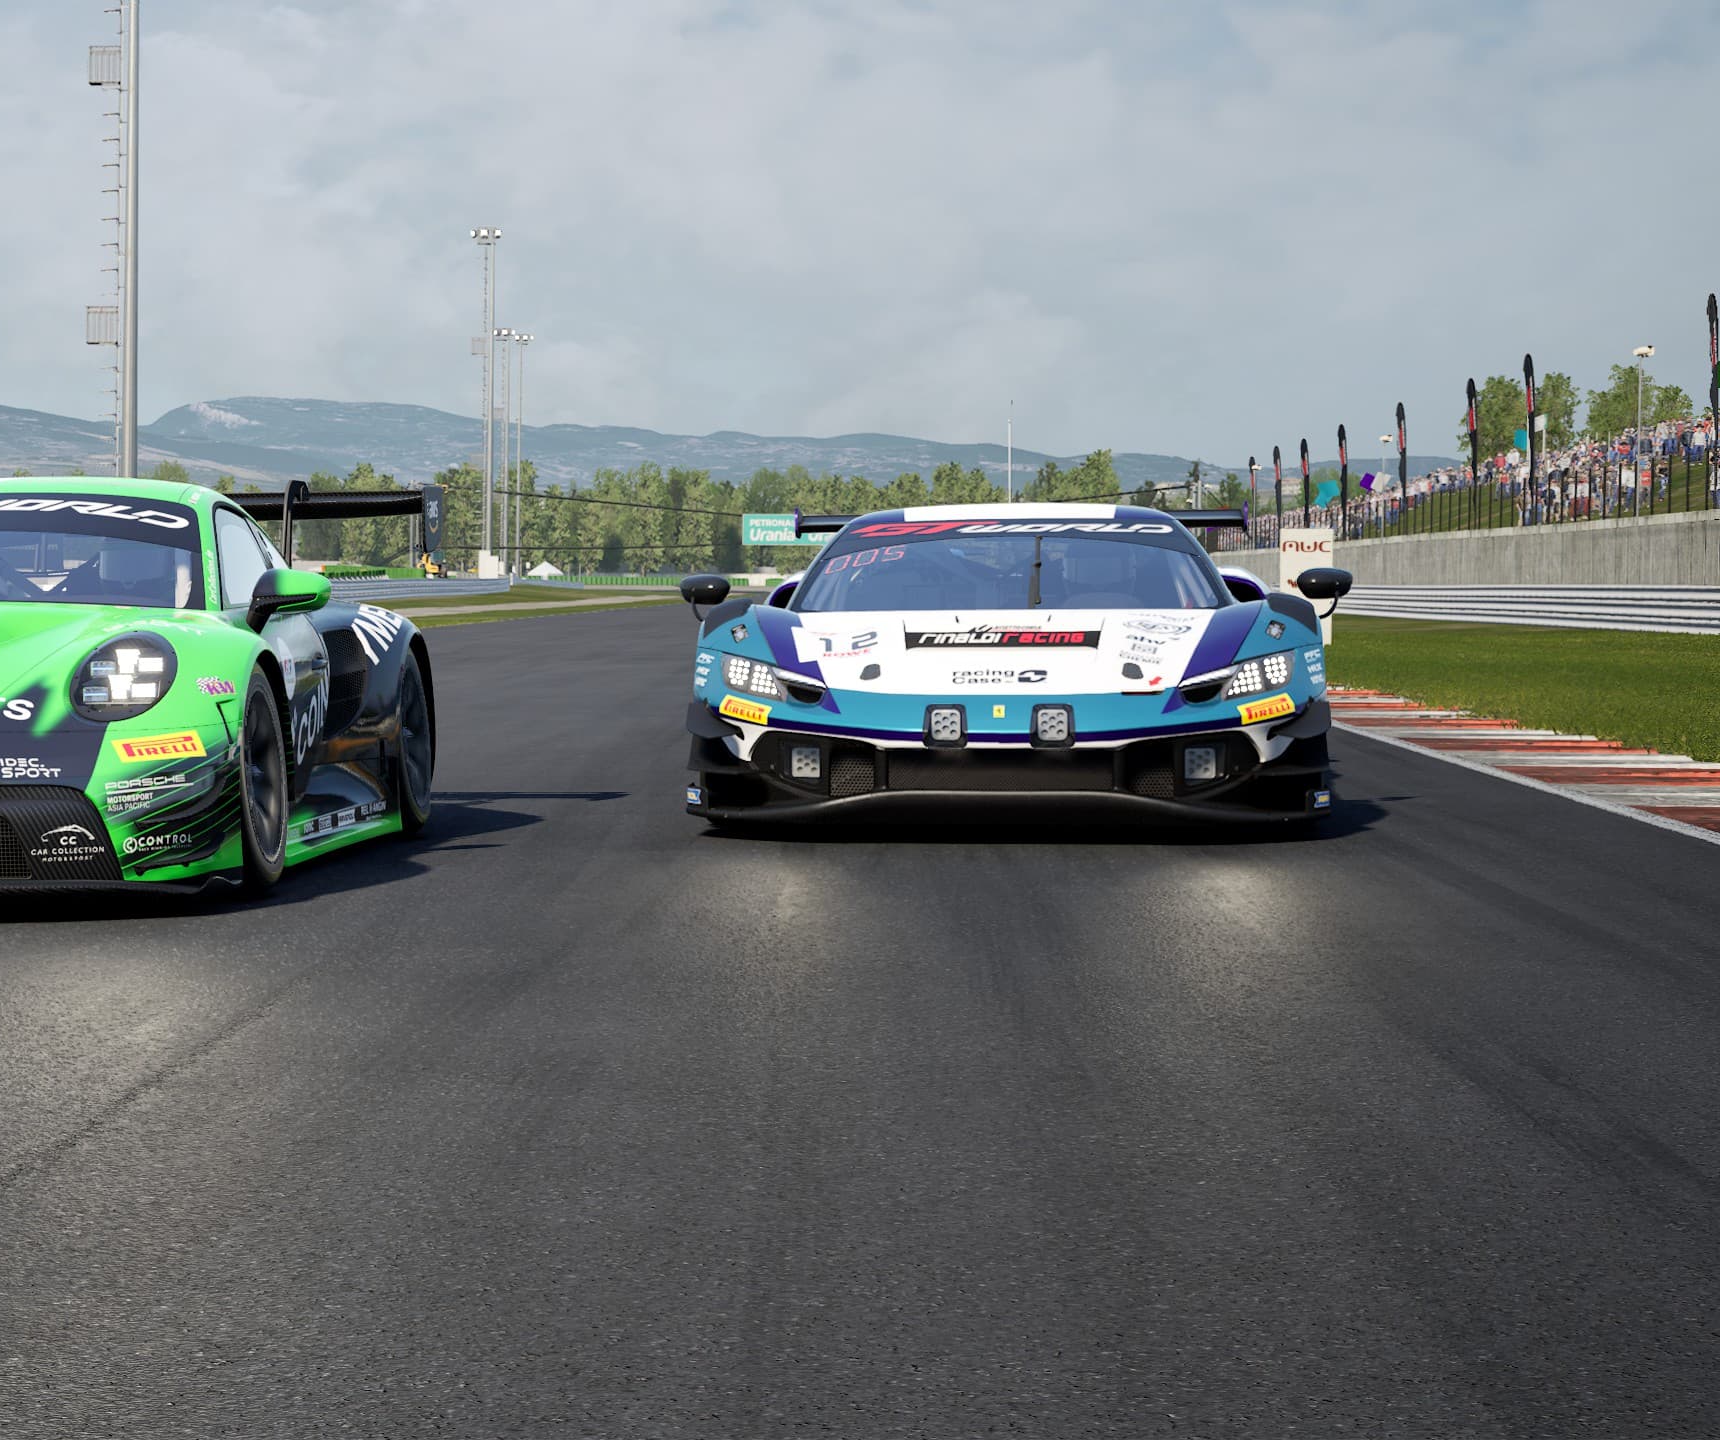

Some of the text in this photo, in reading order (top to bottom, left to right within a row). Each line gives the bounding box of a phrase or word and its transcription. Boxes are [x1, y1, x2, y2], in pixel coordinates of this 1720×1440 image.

[957, 523, 1174, 534] WORLD
[952, 668, 1014, 677] racing
[724, 699, 764, 720] PIRELLI
[1245, 697, 1290, 720] PIRELLI
[122, 736, 198, 757] PIRELLI
[0, 767, 62, 779] SPORT
[105, 774, 186, 789] PORSCHE
[106, 792, 154, 804] MOTORSPORT
[107, 803, 124, 812] ASIA
[59, 836, 77, 845] CC
[138, 833, 192, 847] CONTROL
[30, 846, 105, 856] CAR COLLECTION
